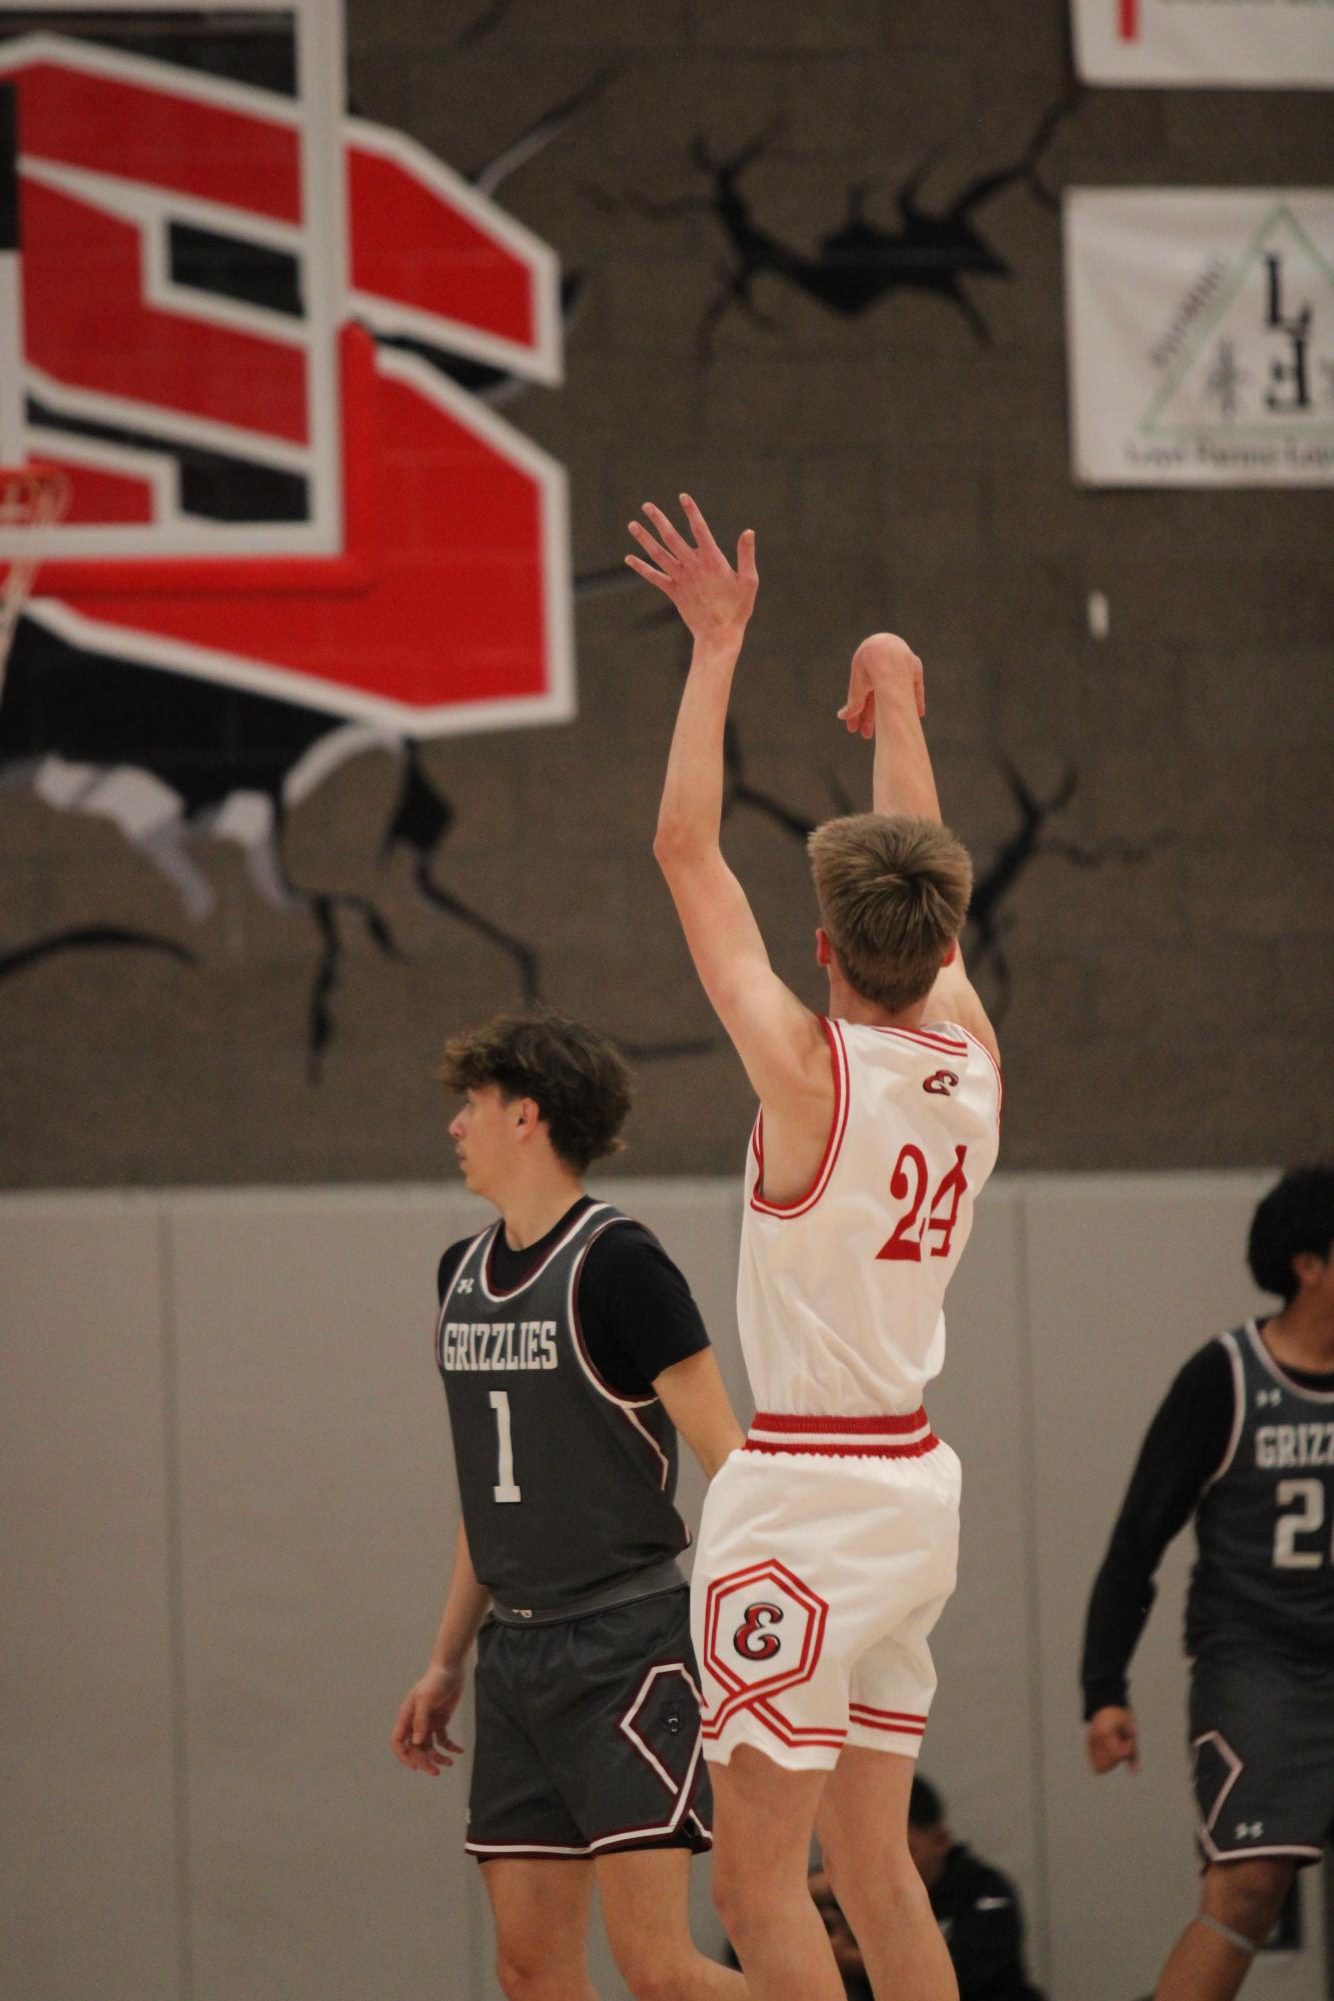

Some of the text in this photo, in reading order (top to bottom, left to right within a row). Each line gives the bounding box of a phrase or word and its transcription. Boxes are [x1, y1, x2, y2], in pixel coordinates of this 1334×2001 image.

[875, 1143, 968, 1263] 24
[443, 1320, 559, 1371] GRIZZLIES
[489, 1390, 522, 1503] 1
[1272, 1477, 1334, 1569] 2
